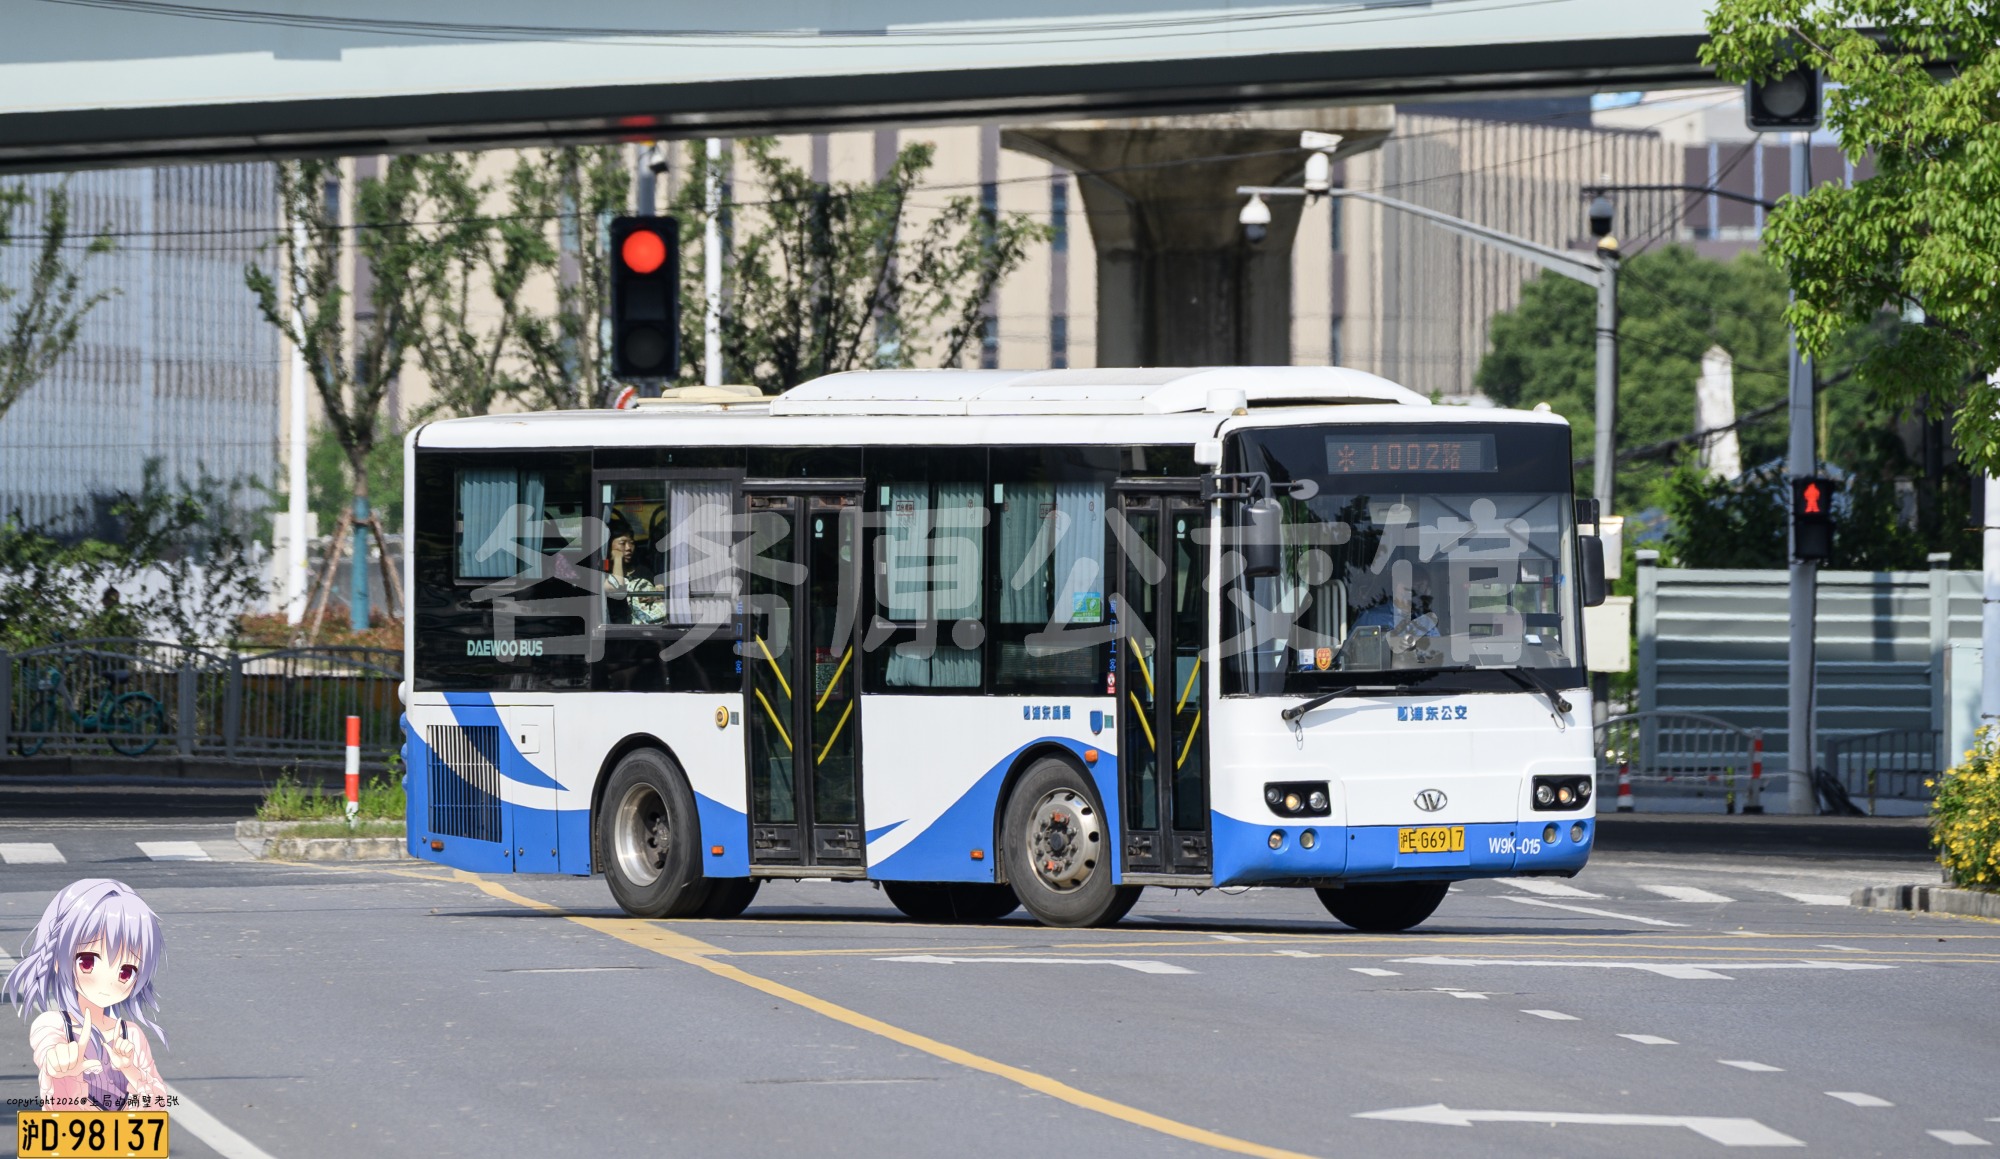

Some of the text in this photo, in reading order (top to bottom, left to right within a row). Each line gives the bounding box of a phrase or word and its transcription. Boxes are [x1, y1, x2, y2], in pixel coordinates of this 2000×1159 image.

[466, 639, 543, 657] DAEWOO BUS
[1409, 704, 1468, 721] 浦东公交
[1488, 837, 1541, 855] W9K-015
